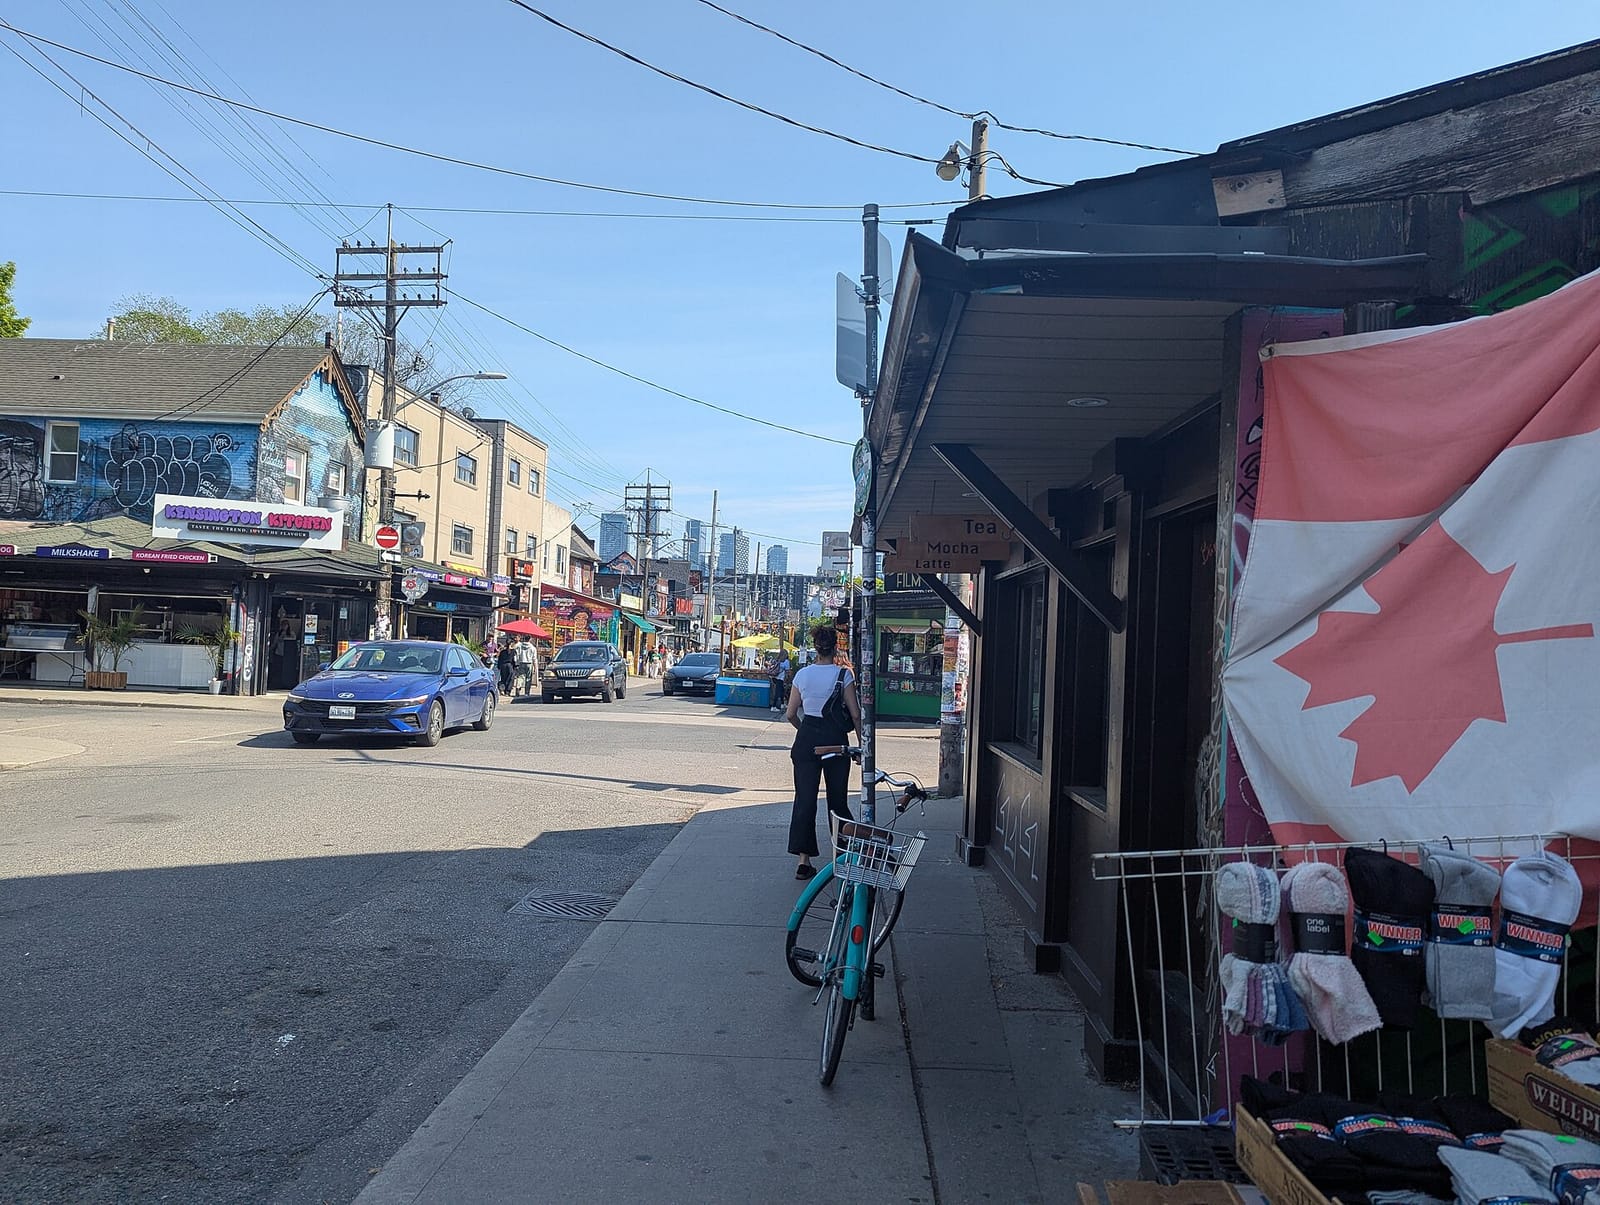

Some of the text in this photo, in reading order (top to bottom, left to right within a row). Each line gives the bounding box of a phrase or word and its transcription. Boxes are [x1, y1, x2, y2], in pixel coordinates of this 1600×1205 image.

[164, 503, 332, 530] KENSINGTON KITCHEN
[964, 519, 997, 534] Tea
[51, 548, 100, 558] MILKSHAKE
[927, 541, 979, 555] Mocha
[135, 552, 160, 560] KOREAN
[915, 559, 951, 569] Latte
[896, 573, 921, 588] FILM
[1306, 918, 1325, 926] one
[1307, 924, 1330, 934] label
[1506, 921, 1564, 949] WINNER
